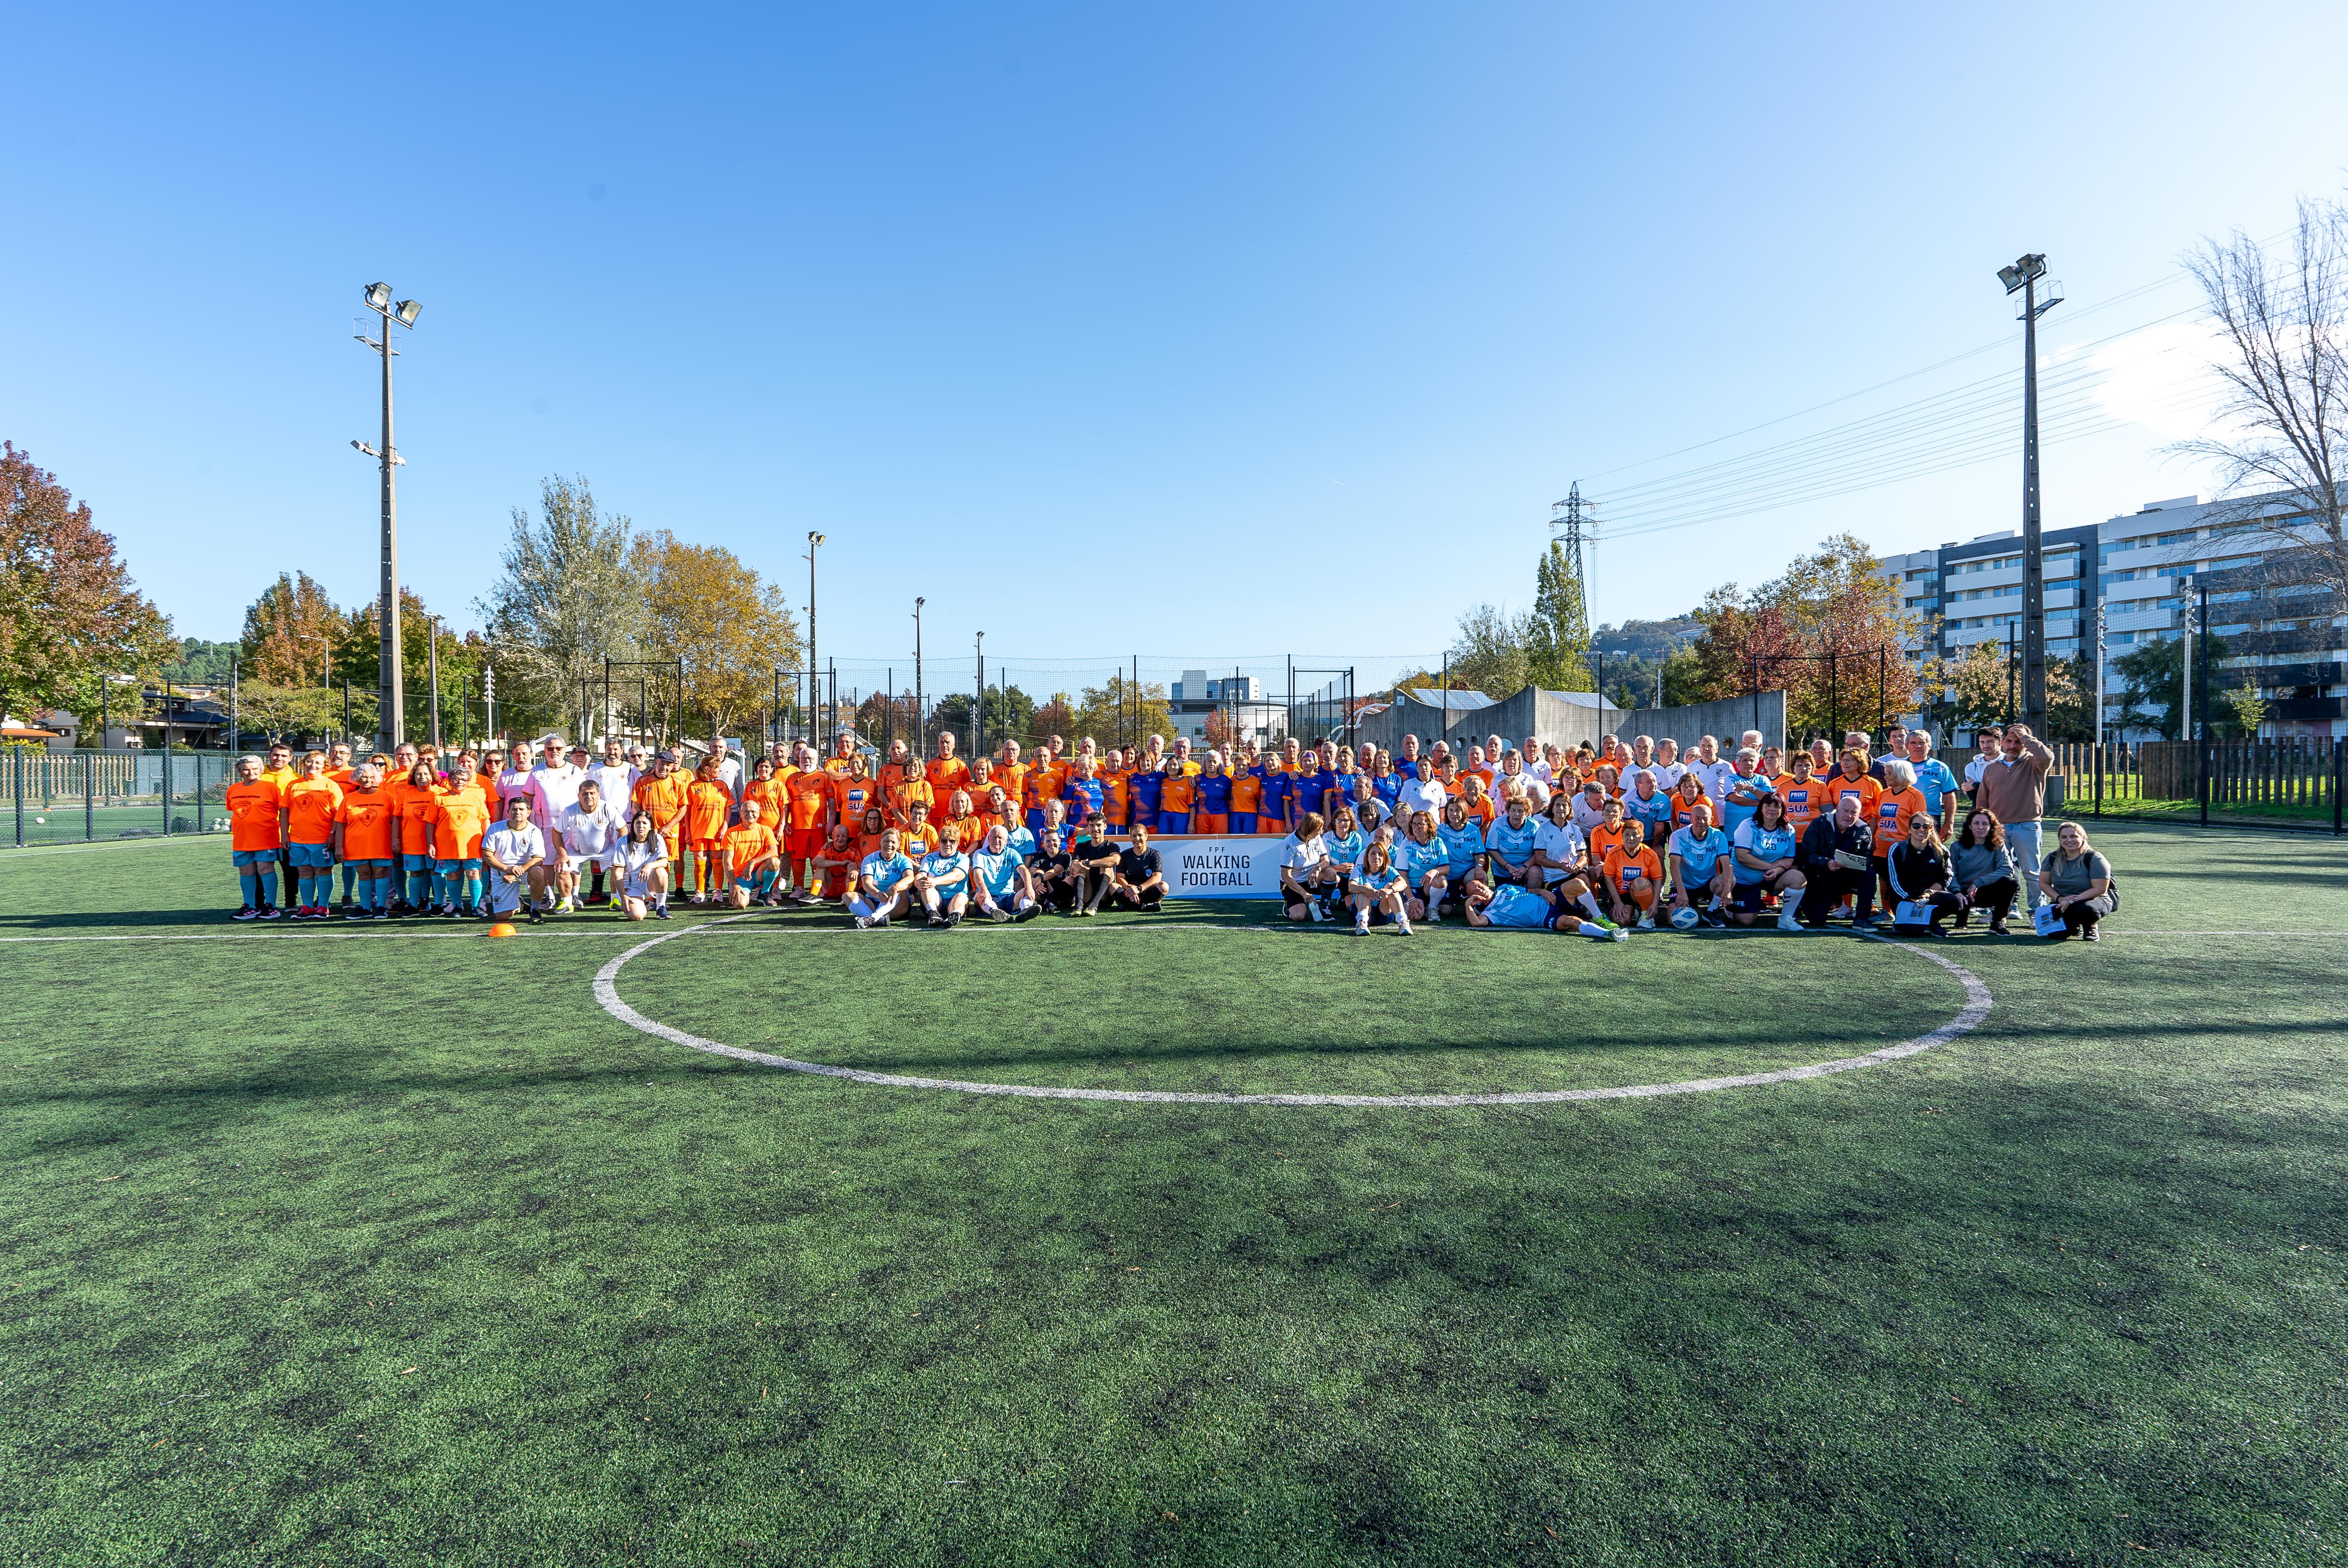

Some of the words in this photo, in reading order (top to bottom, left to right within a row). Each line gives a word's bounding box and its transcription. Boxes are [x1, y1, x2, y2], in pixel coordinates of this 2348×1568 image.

[1788, 804, 1809, 813] SUA
[1880, 819, 1897, 829] SUA
[1765, 842, 1777, 851] 20
[322, 848, 330, 859] 5
[1183, 855, 1250, 869] WALKING
[1181, 872, 1253, 886] FOOTBALL
